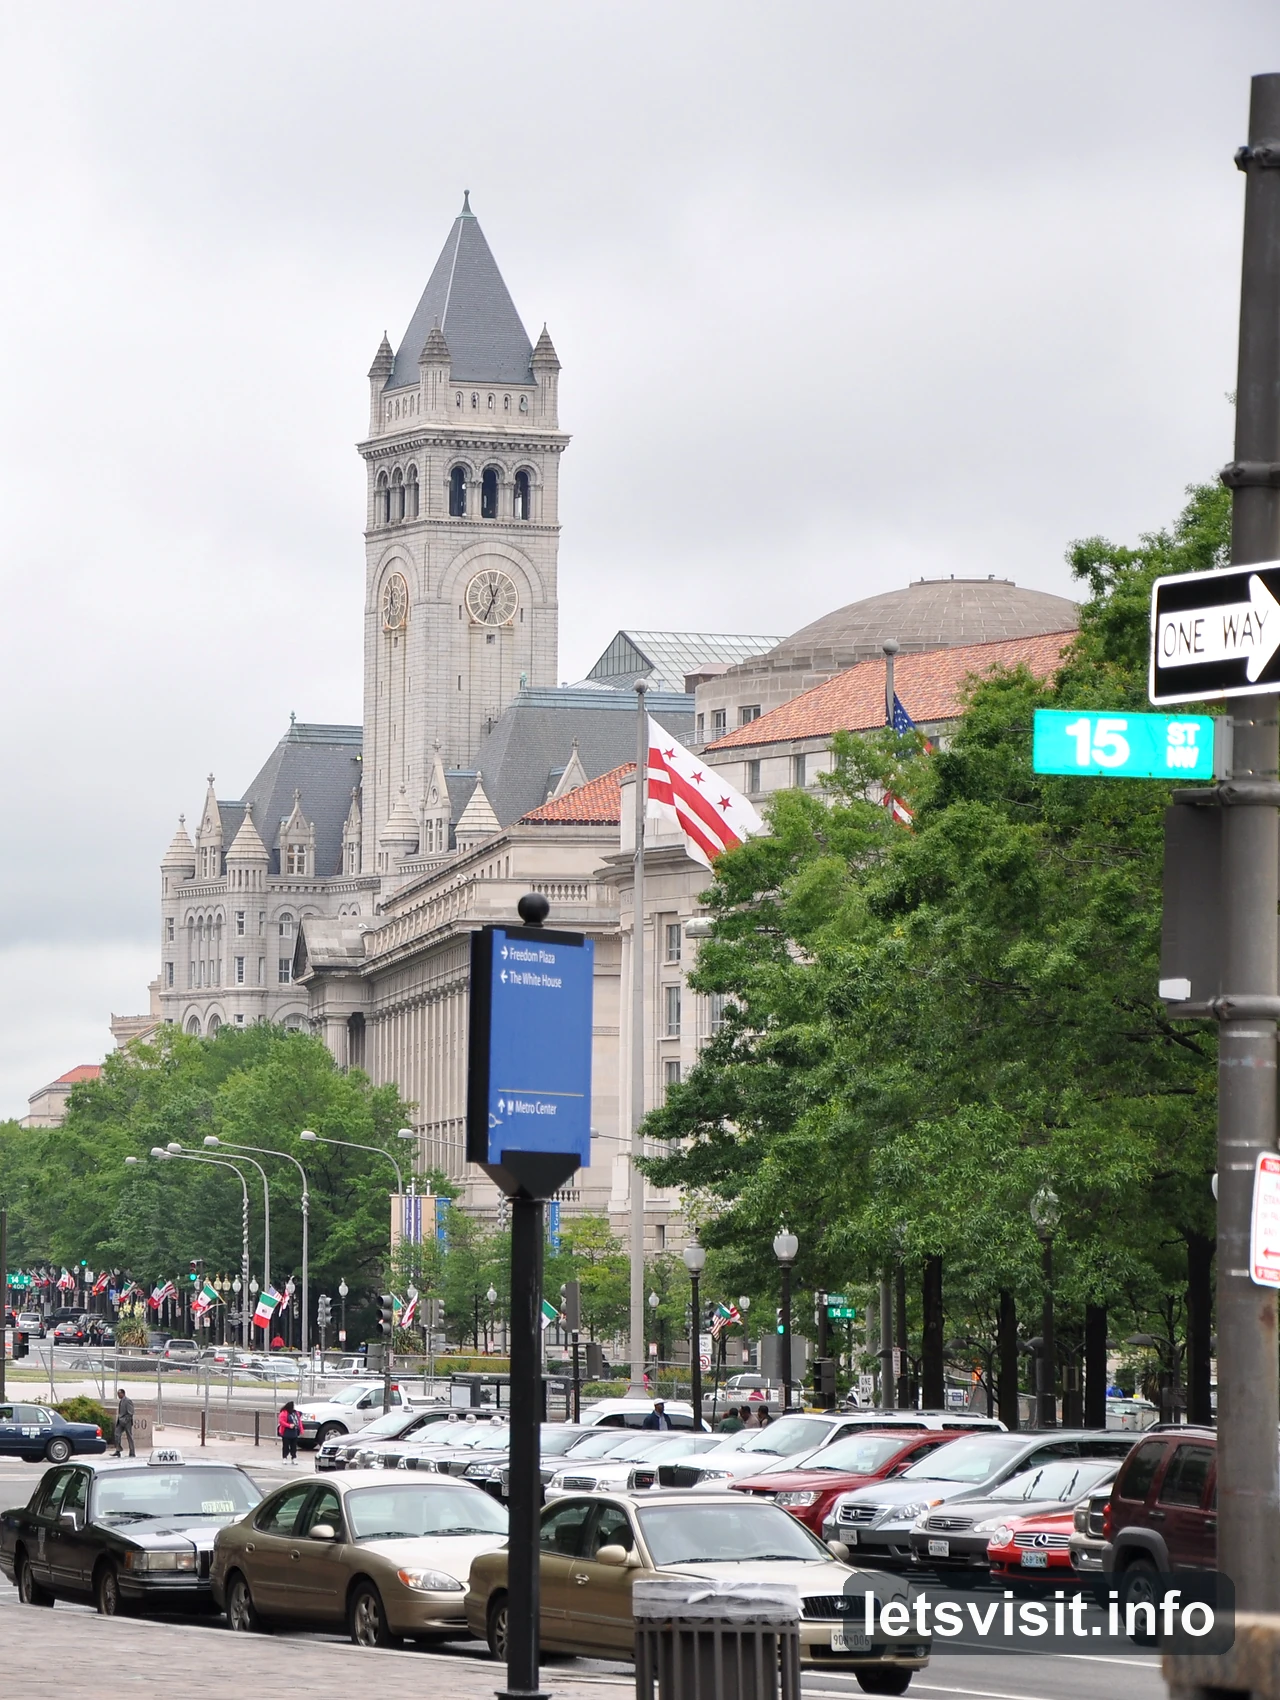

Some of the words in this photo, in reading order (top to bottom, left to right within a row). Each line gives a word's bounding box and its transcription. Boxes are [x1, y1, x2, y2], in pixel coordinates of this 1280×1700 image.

[1163, 618, 1205, 658] ONE
[1223, 610, 1269, 649] WAY
[1167, 722, 1200, 745] ST
[1065, 718, 1130, 768] 15
[1167, 746, 1199, 768] NW
[510, 947, 538, 962] Freedom
[539, 950, 556, 964] Plaza
[510, 970, 522, 984] The
[522, 972, 541, 986] White
[541, 974, 562, 988] House
[515, 1100, 535, 1114] Metro
[535, 1101, 557, 1115] Center
[831, 1307, 841, 1317] 14
[861, 1377, 871, 1386] ONE
[861, 1386, 872, 1395] WAY
